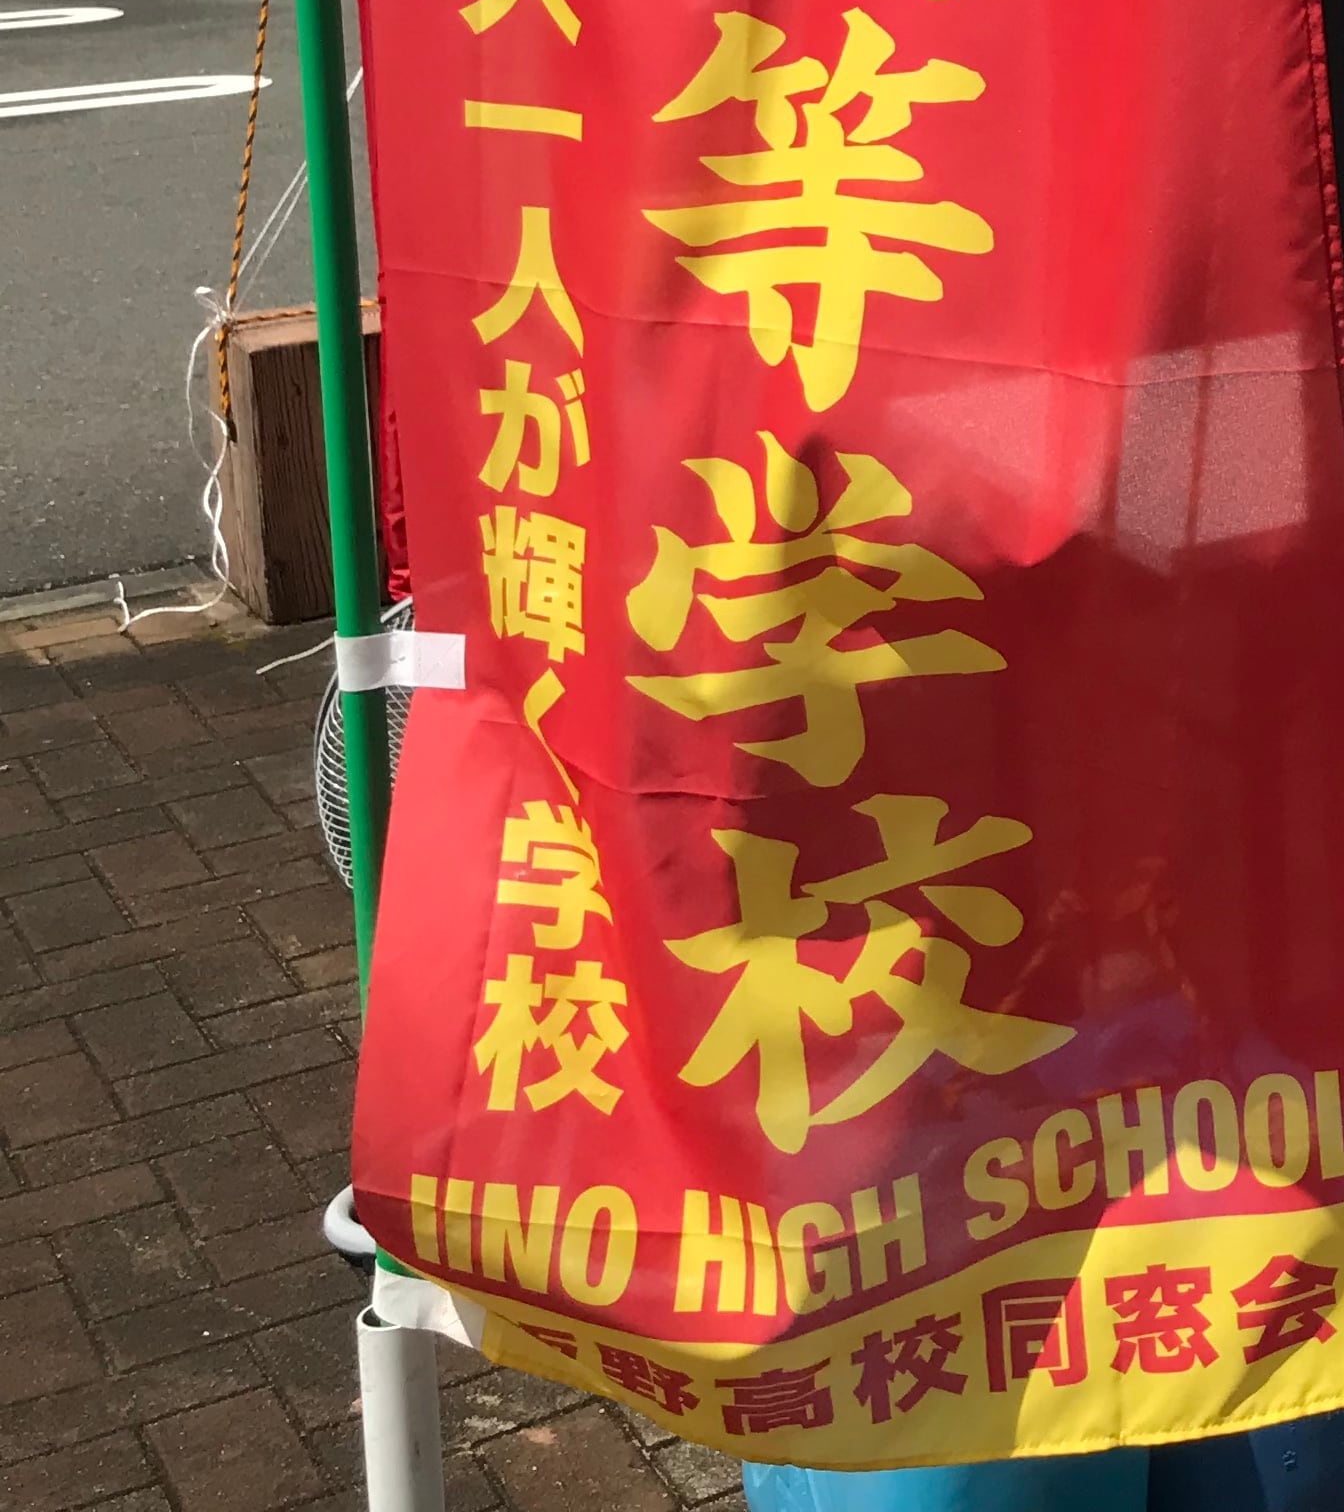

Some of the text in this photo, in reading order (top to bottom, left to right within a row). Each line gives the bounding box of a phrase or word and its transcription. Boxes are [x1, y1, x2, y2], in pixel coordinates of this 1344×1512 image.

[411, 1172, 637, 1308] IINO
[672, 1172, 927, 1317] HIGH
[519, 1252, 1341, 1437] 野高校同窓会
